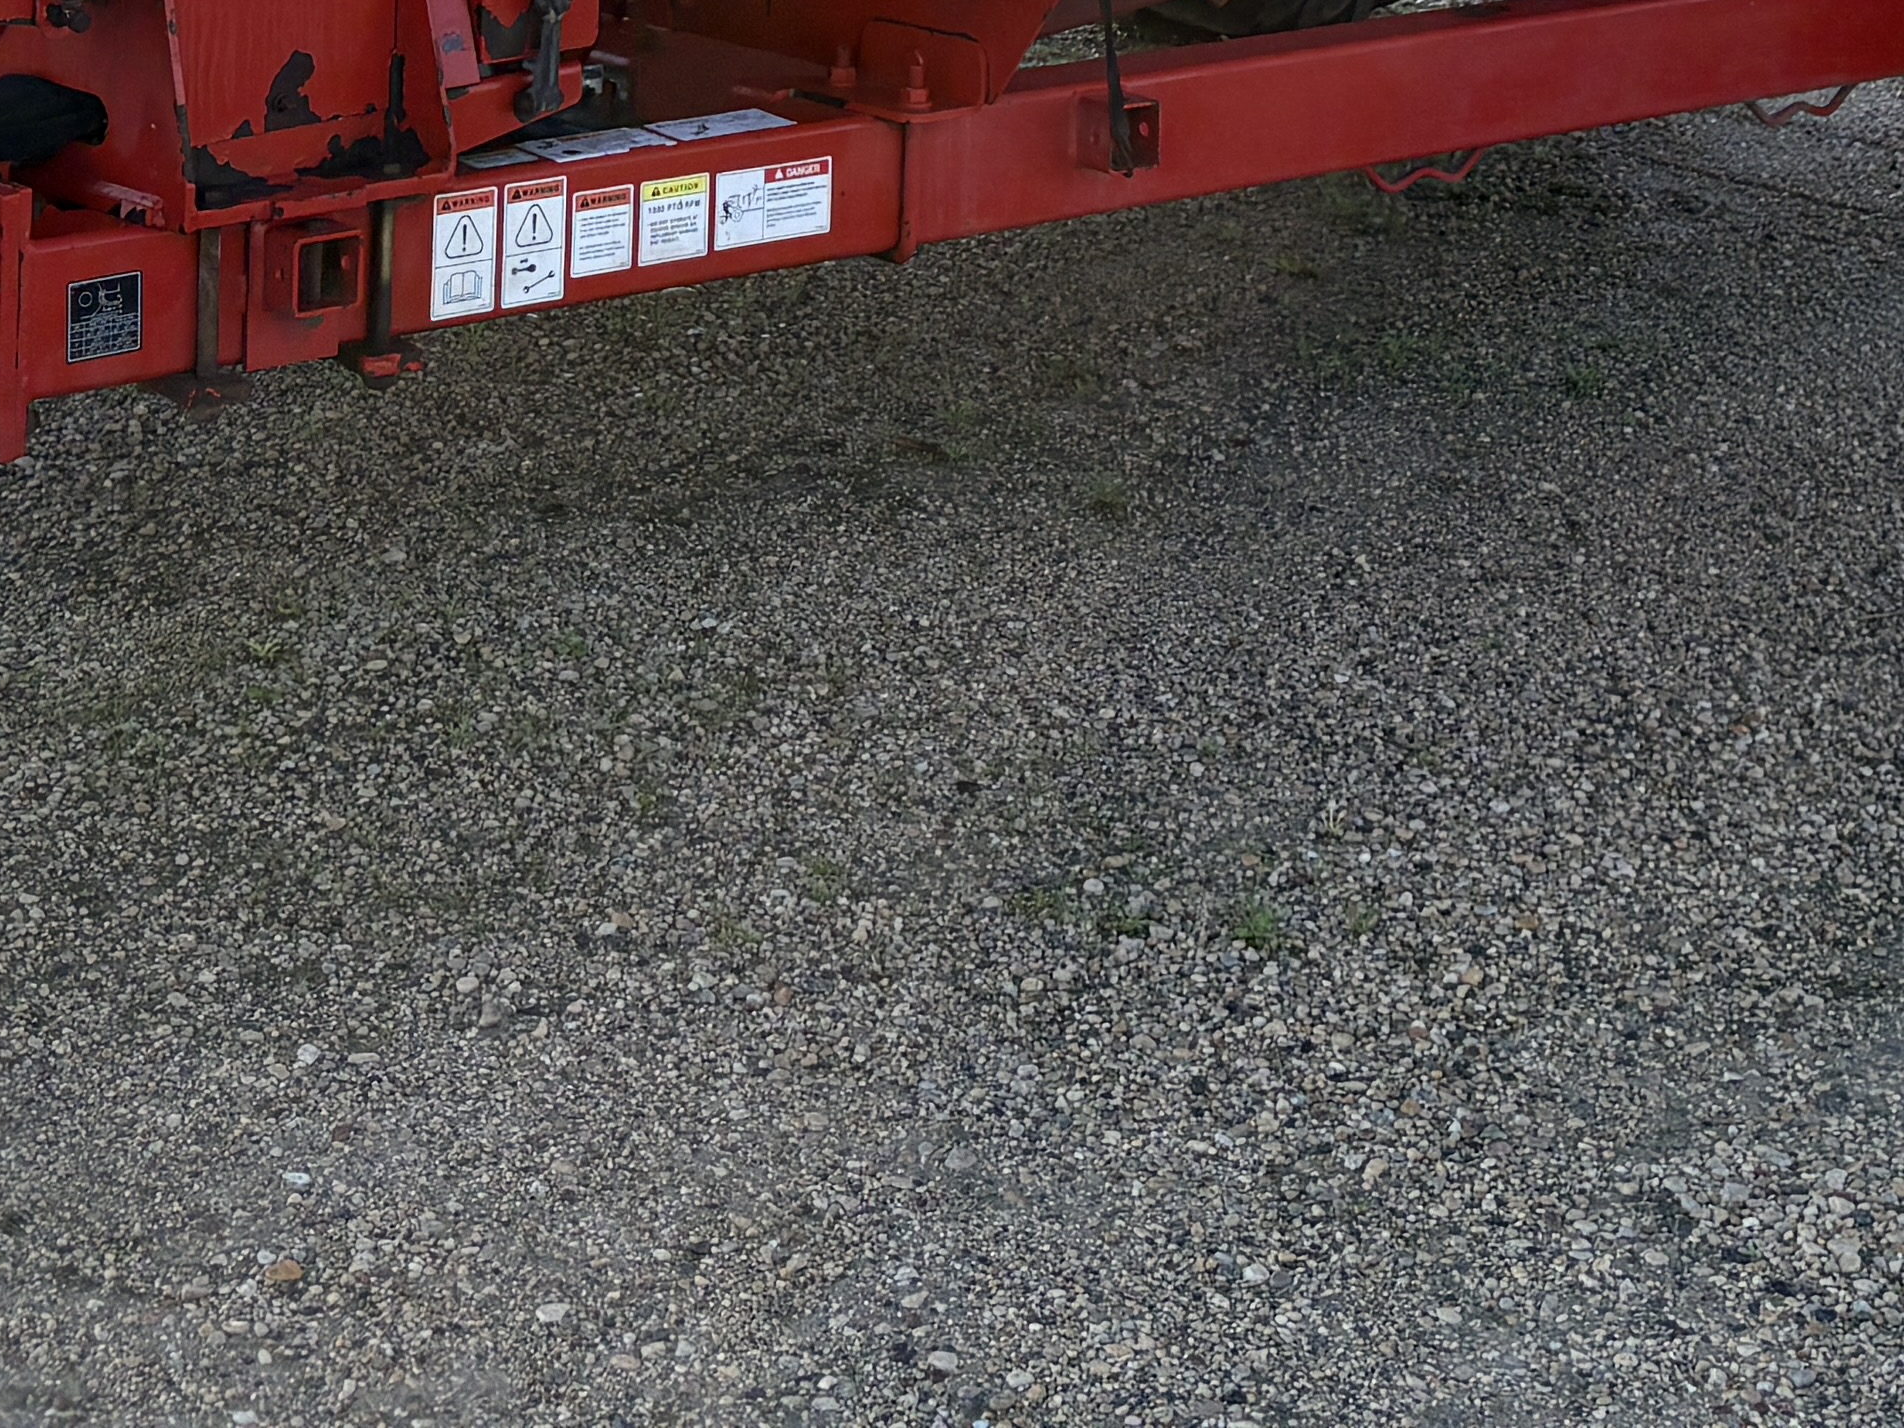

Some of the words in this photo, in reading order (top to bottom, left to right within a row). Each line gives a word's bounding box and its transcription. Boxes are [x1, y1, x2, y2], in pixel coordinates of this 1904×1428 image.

[785, 163, 821, 178] DANGER
[521, 183, 560, 198] WARNING
[662, 182, 699, 195] CAUTION
[452, 195, 491, 208] WARNING
[590, 193, 627, 205] WARNING
